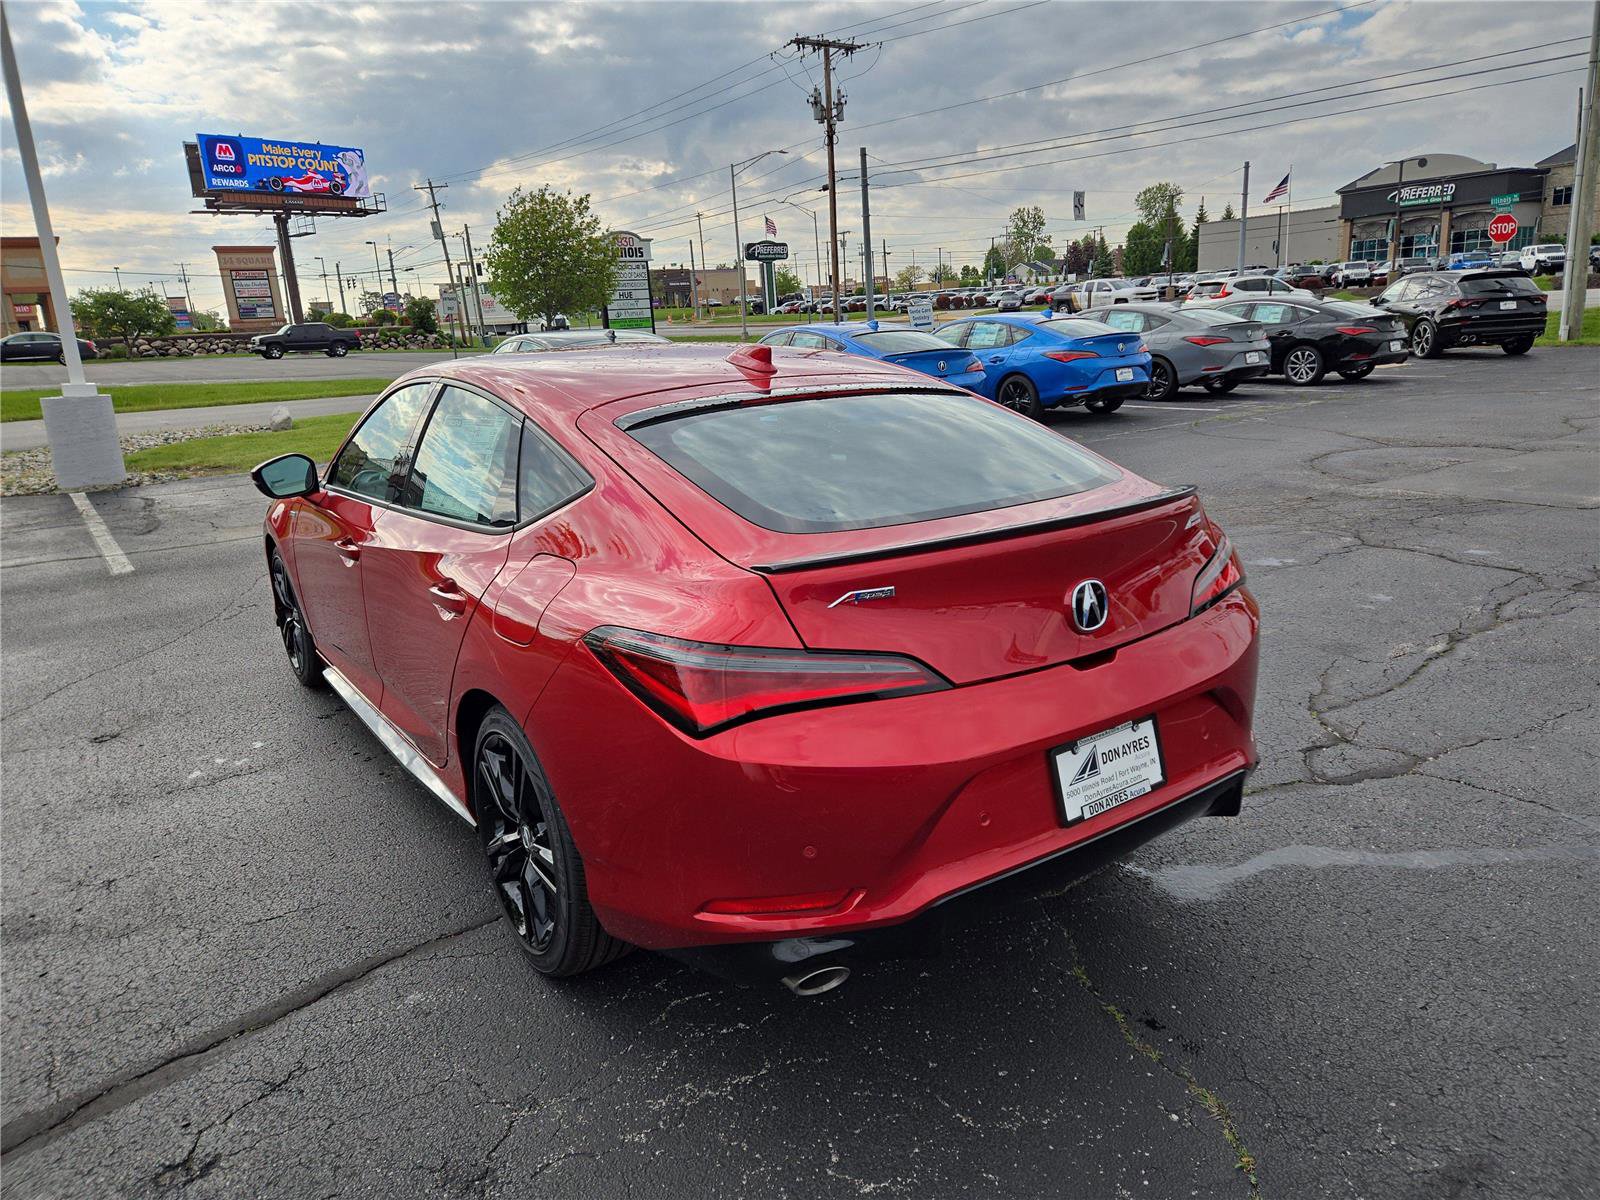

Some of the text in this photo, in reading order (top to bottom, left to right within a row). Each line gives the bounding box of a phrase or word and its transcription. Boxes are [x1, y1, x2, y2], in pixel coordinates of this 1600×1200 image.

[262, 143, 321, 160] Make Every
[213, 164, 235, 173] ARCO
[248, 154, 339, 173] PITSTOP COUNT
[212, 178, 249, 188] REWARDS
[1387, 183, 1455, 203] PREFERRED
[1490, 196, 1512, 206] Illinois
[1490, 222, 1516, 235] STOP
[748, 244, 787, 257] PREFERRED
[1101, 736, 1150, 765] DON AYRES
[1066, 757, 1156, 800] 5000 Illinois Road Fort Wayne, IN
[1084, 774, 1143, 802] DonAyresAcura.com
[1088, 786, 1146, 816] DON AYRES Acura
